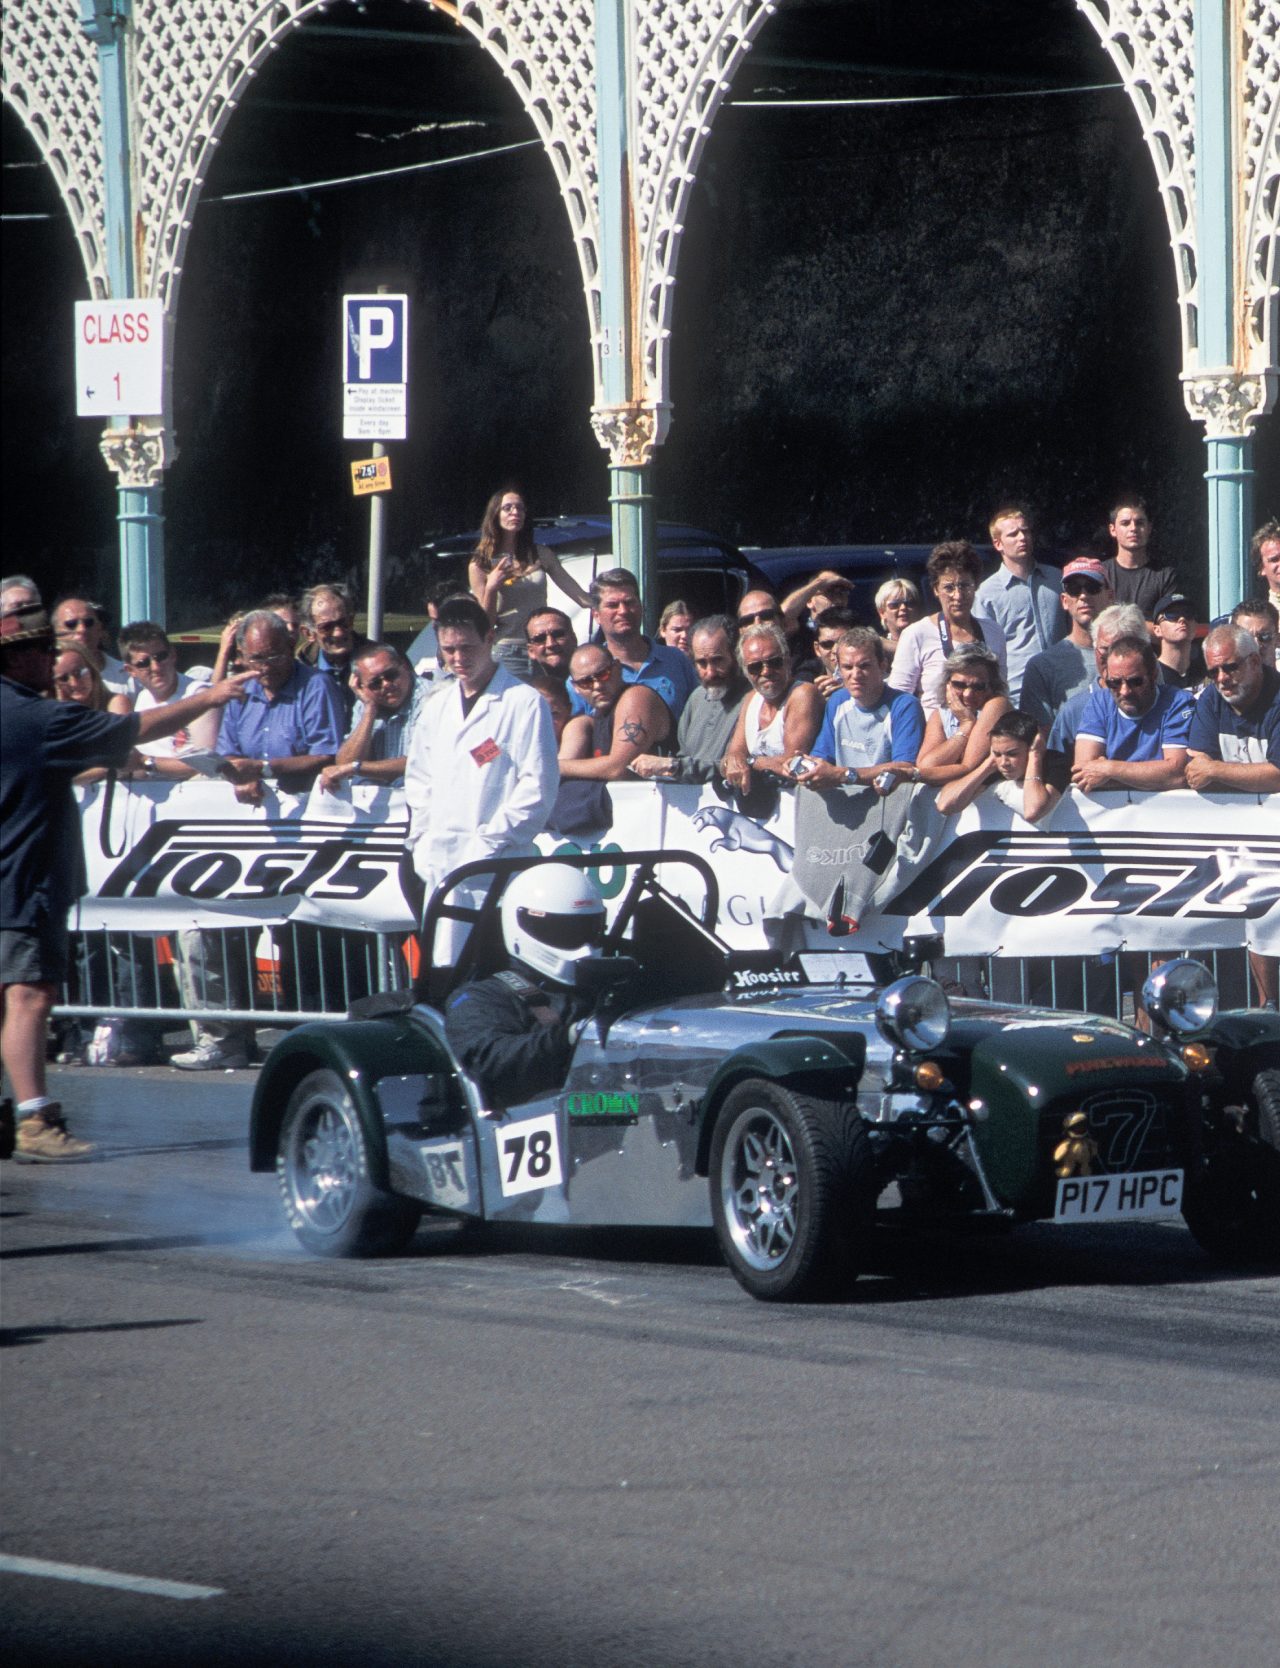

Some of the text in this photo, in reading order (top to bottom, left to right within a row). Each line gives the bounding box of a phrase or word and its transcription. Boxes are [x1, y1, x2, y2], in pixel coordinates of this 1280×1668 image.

[83, 312, 149, 345] CLASS
[359, 306, 394, 379] P
[113, 371, 120, 401] 1
[734, 967, 800, 987] Hoosier
[504, 1131, 552, 1183] 78
[1060, 1174, 1178, 1215] P17 HPC
